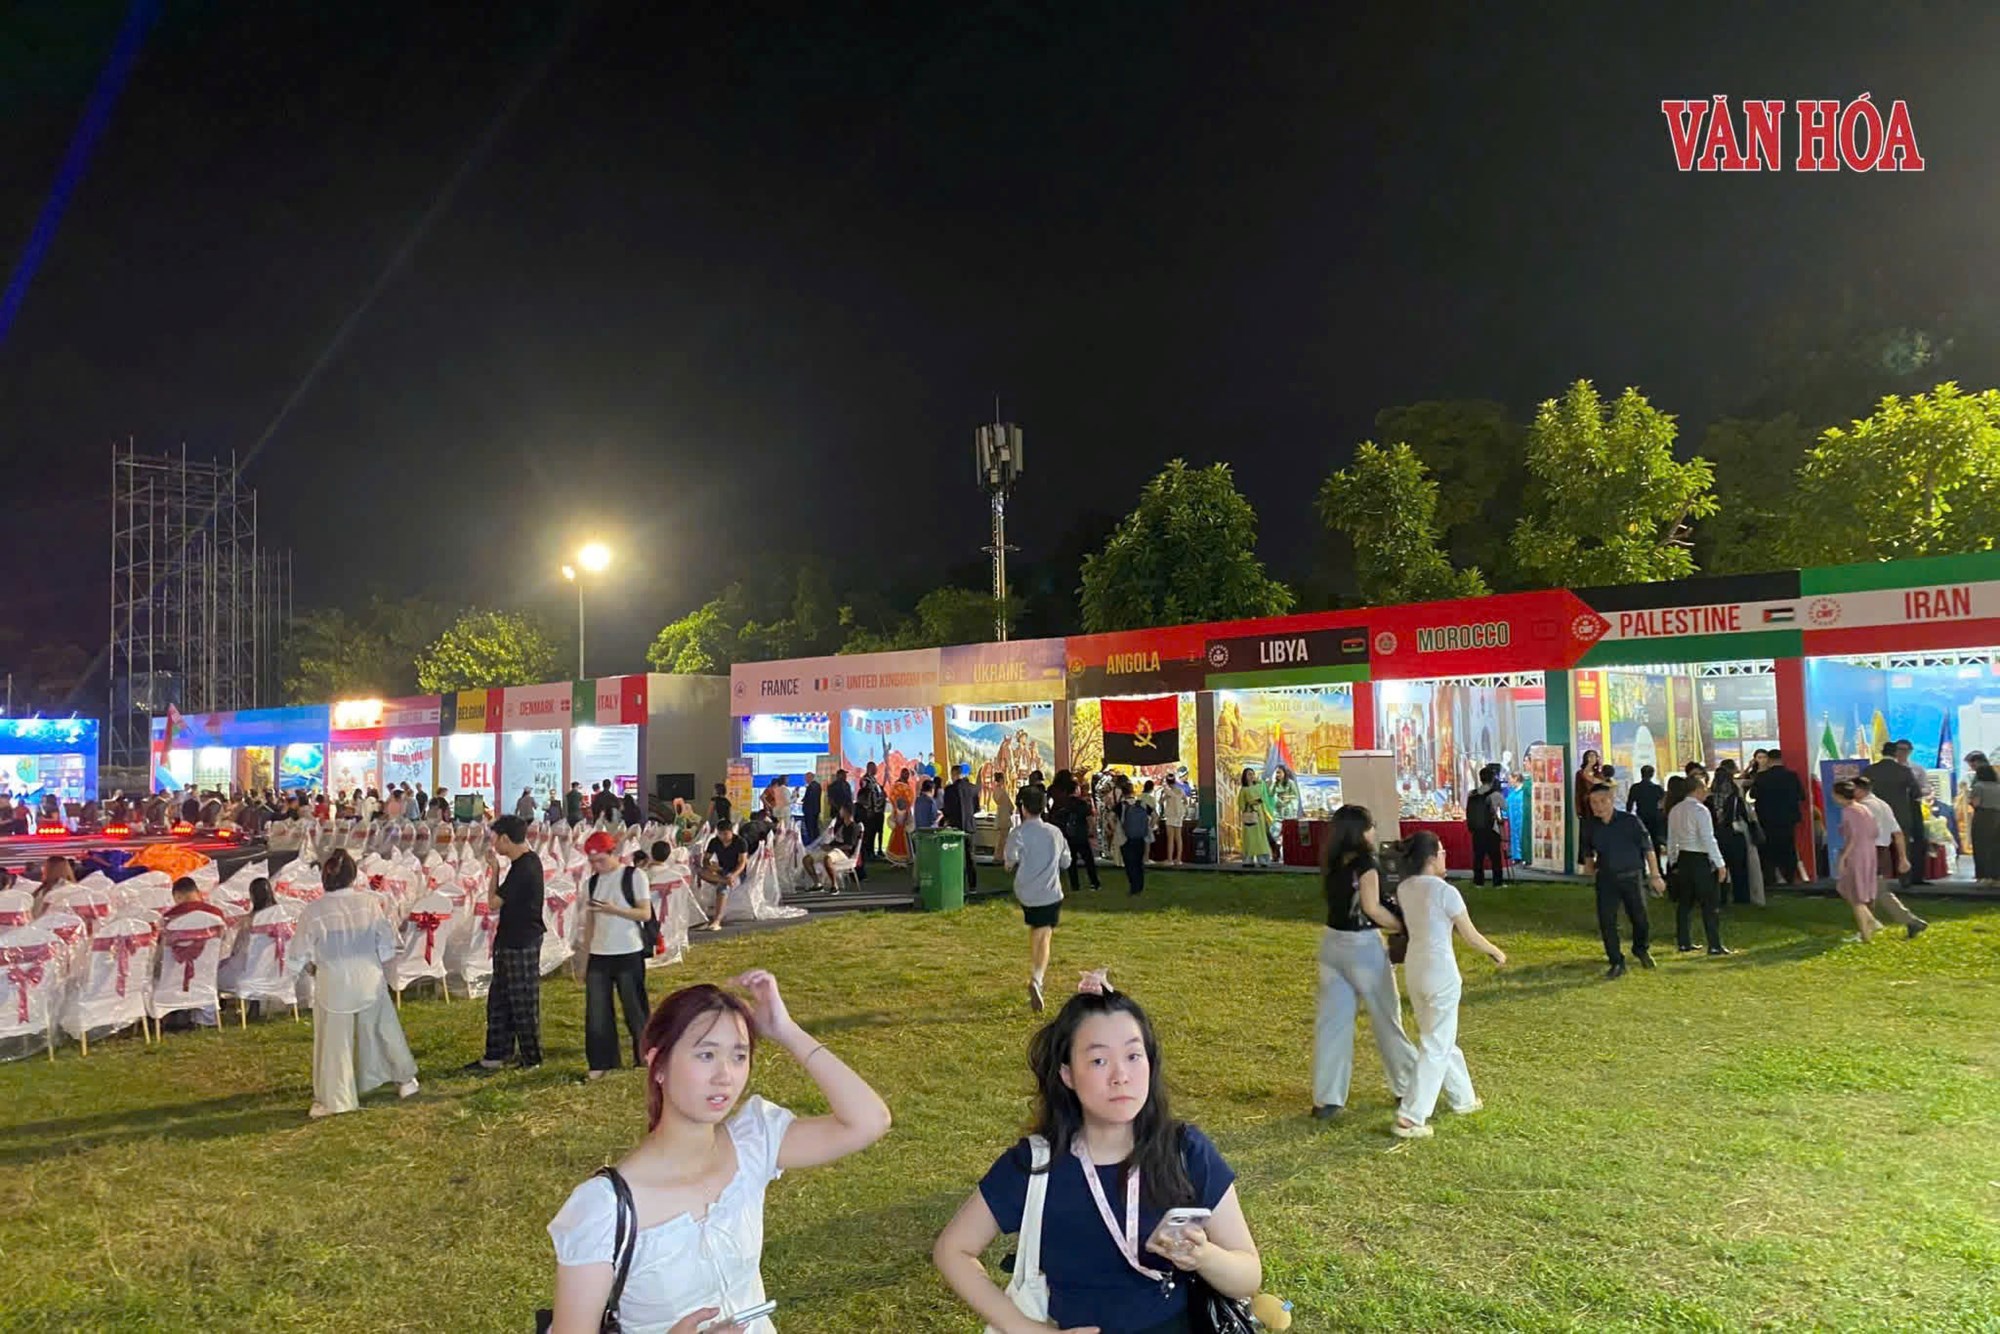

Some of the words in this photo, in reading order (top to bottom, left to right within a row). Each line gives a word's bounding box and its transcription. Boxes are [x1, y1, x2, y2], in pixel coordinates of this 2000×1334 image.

[1904, 587, 1972, 619] IRAN
[1619, 605, 1742, 638] PALESTINE
[1416, 620, 1510, 654] MOROCCO
[1260, 638, 1309, 664] LIBYA
[973, 661, 1027, 682] UKRAINE
[1106, 651, 1161, 674] ANGOLA
[761, 678, 800, 697] FRANCE
[846, 674, 878, 690] UNITED
[519, 699, 555, 716] DENMARK
[597, 694, 620, 711] ITALY
